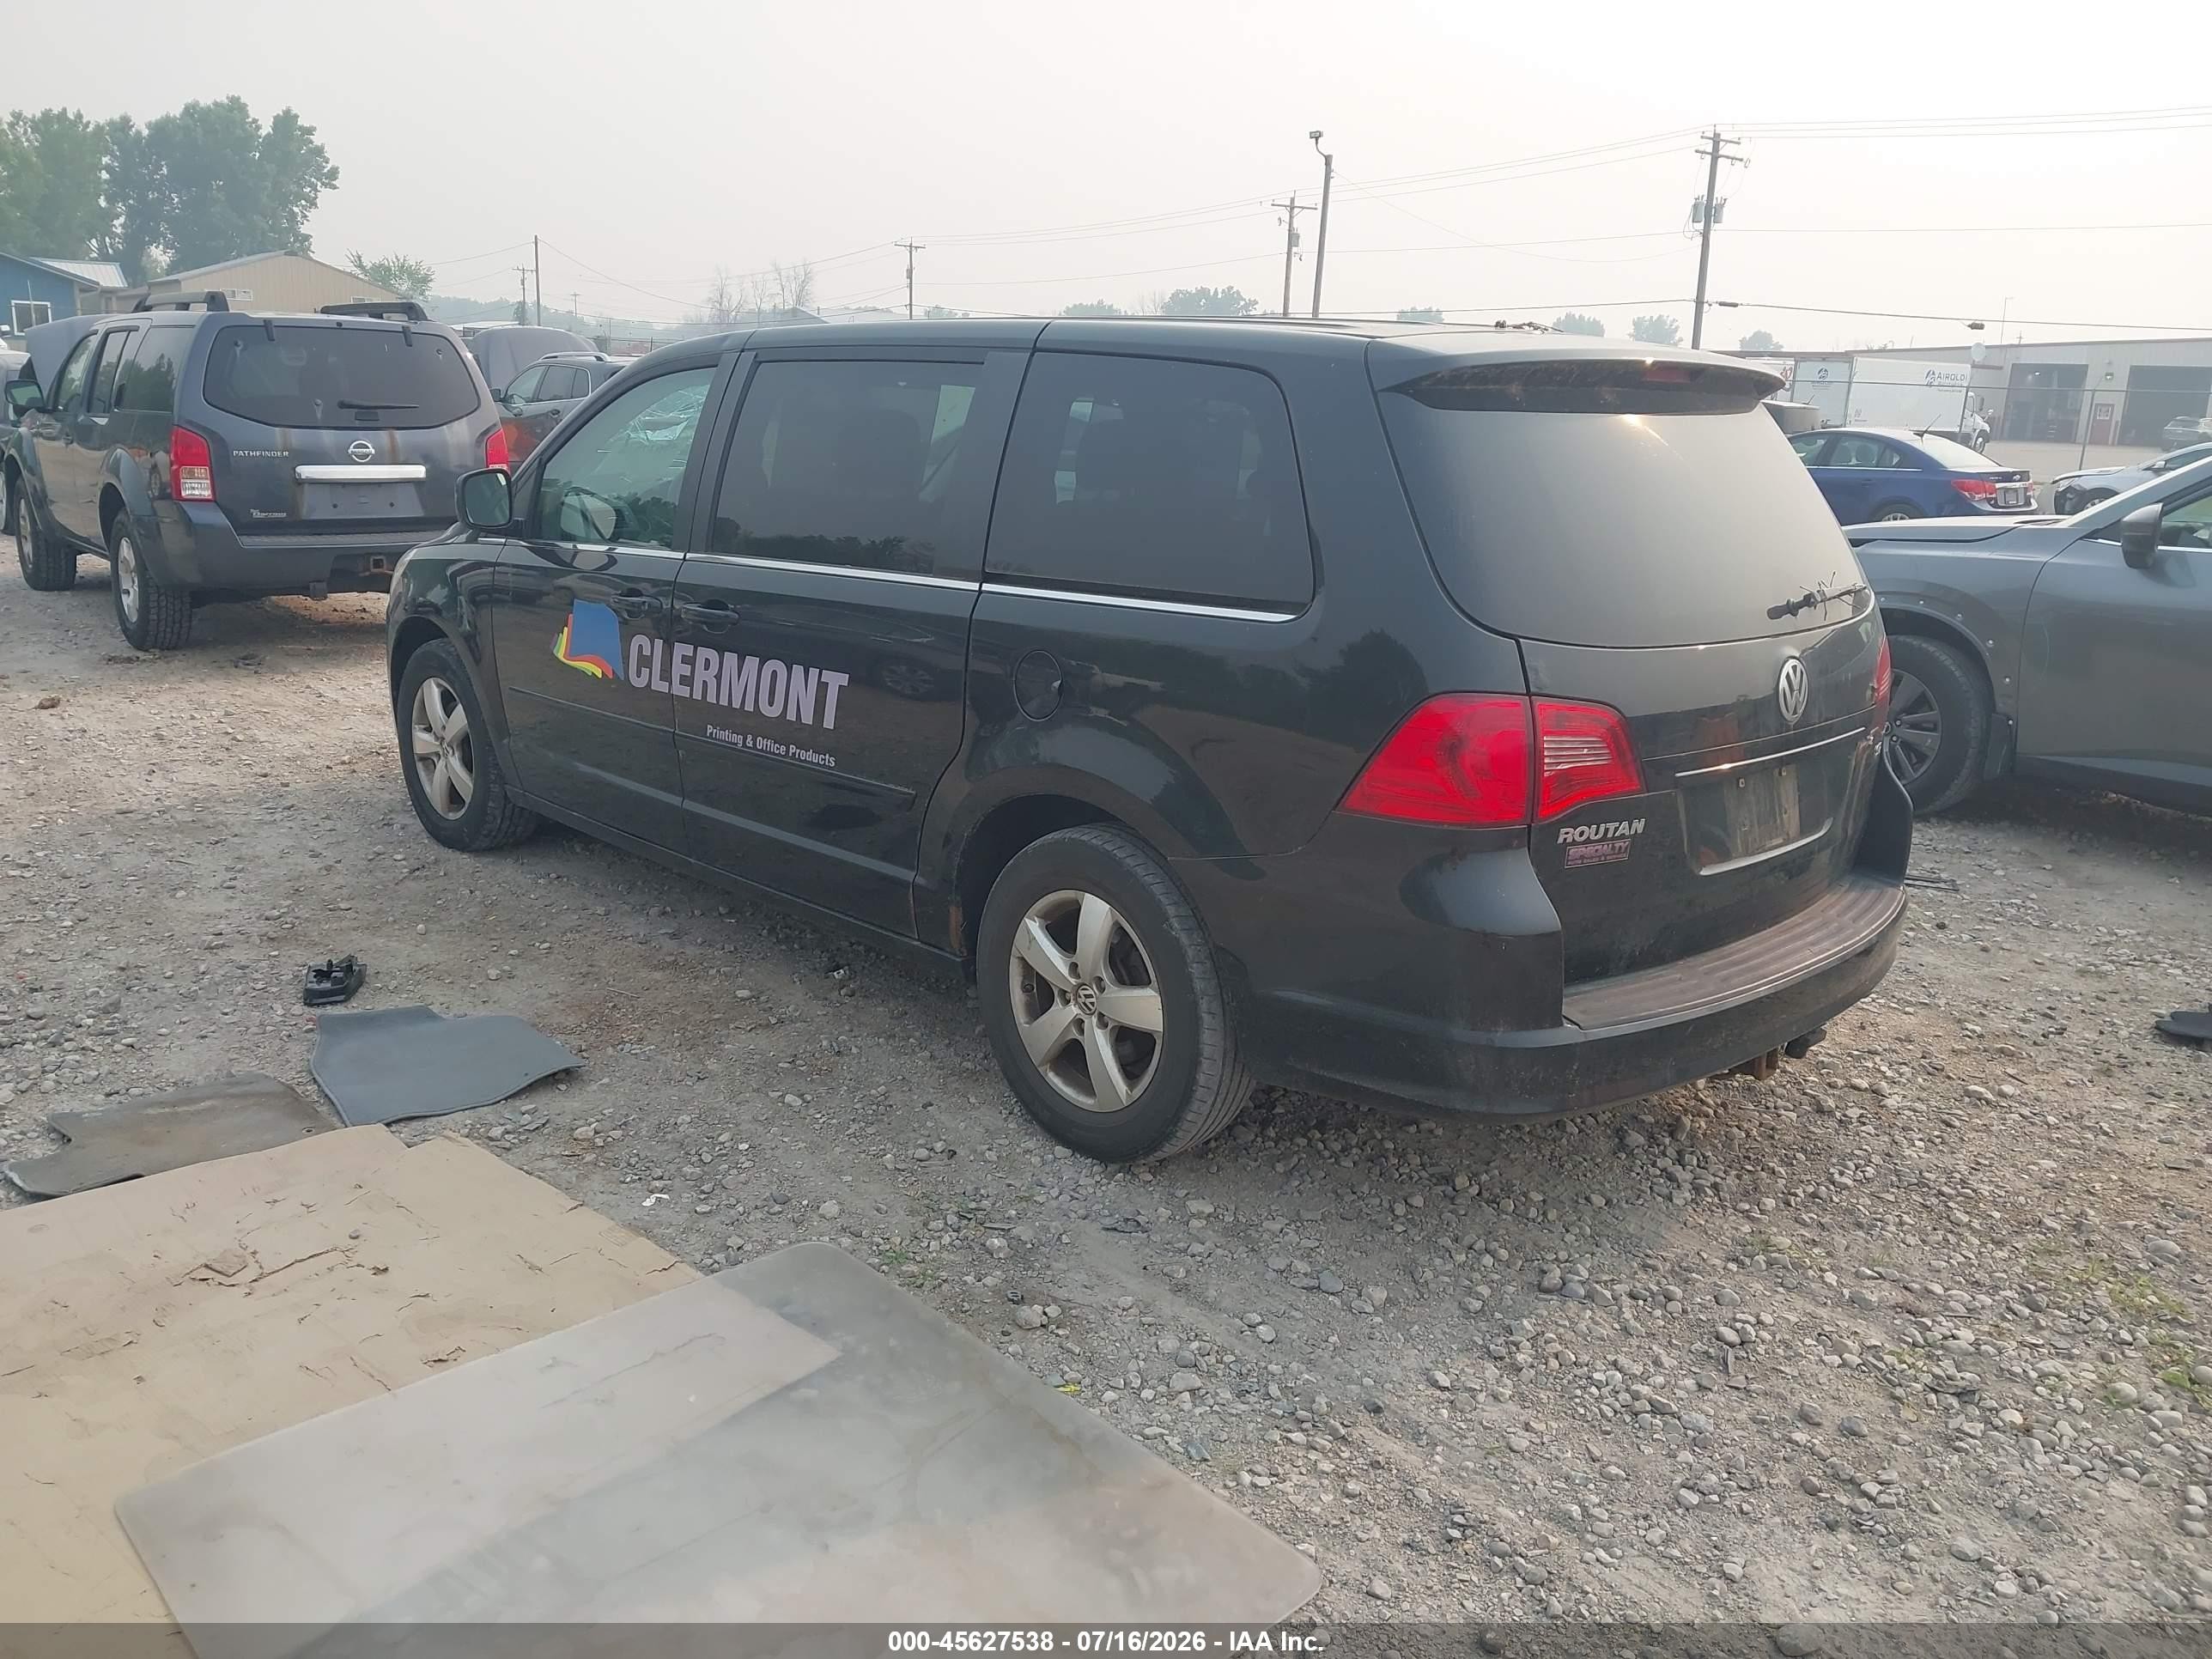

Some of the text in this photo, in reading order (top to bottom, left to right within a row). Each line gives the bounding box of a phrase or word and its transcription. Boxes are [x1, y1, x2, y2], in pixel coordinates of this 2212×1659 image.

[629, 634, 850, 730] CLERMONT
[707, 724, 836, 768] Printing & Office Products
[1557, 818, 1646, 844] ROUTAN
[1568, 842, 1630, 860] SPECIALTY
